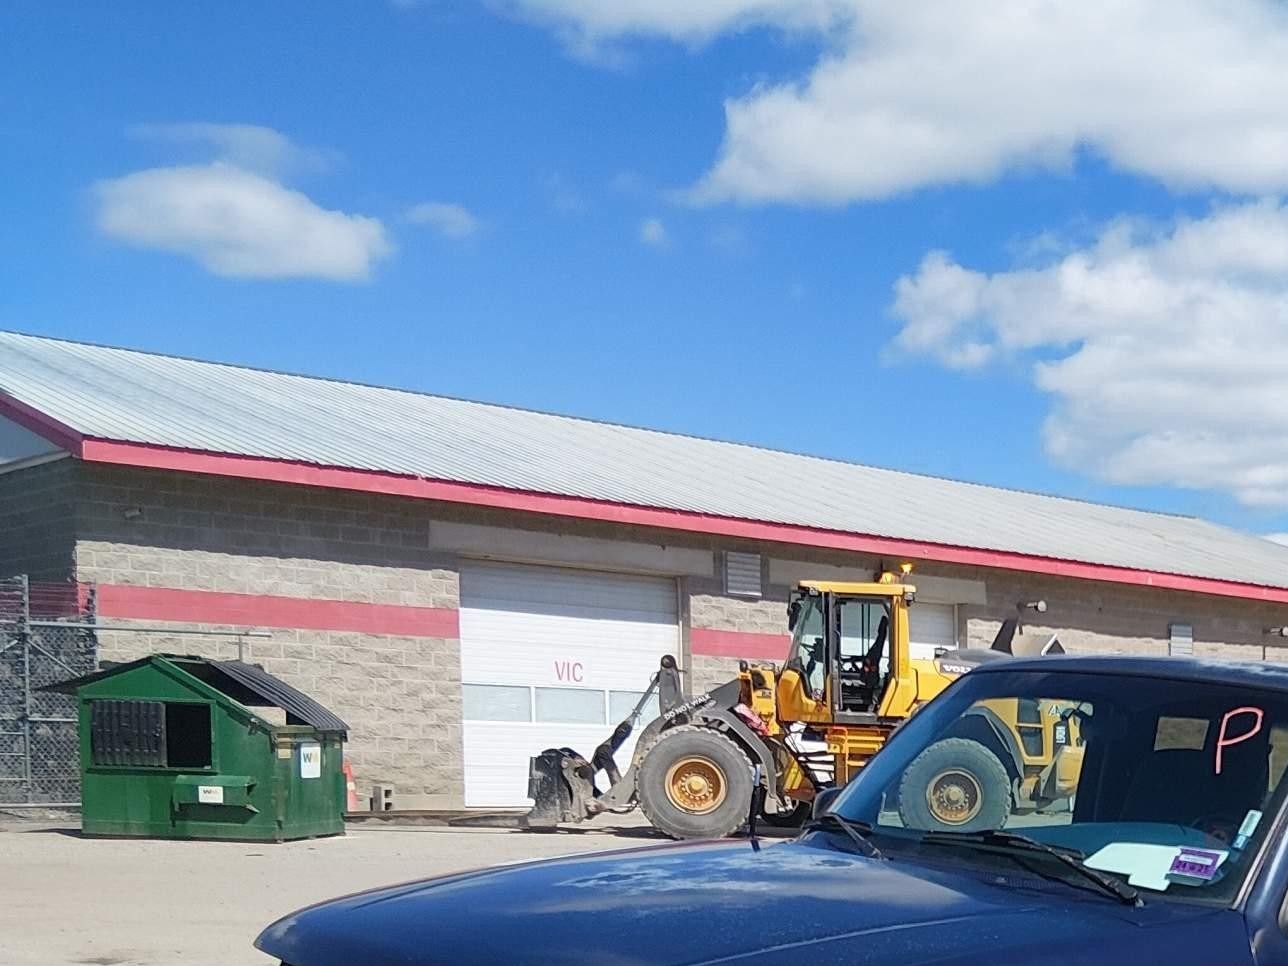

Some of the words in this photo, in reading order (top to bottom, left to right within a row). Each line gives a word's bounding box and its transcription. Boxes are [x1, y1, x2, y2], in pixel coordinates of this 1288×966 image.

[554, 661, 584, 682] VIC
[664, 710, 676, 720] DO
[674, 702, 691, 714] NOT
[690, 693, 712, 706] WALK
[1214, 706, 1265, 775] P
